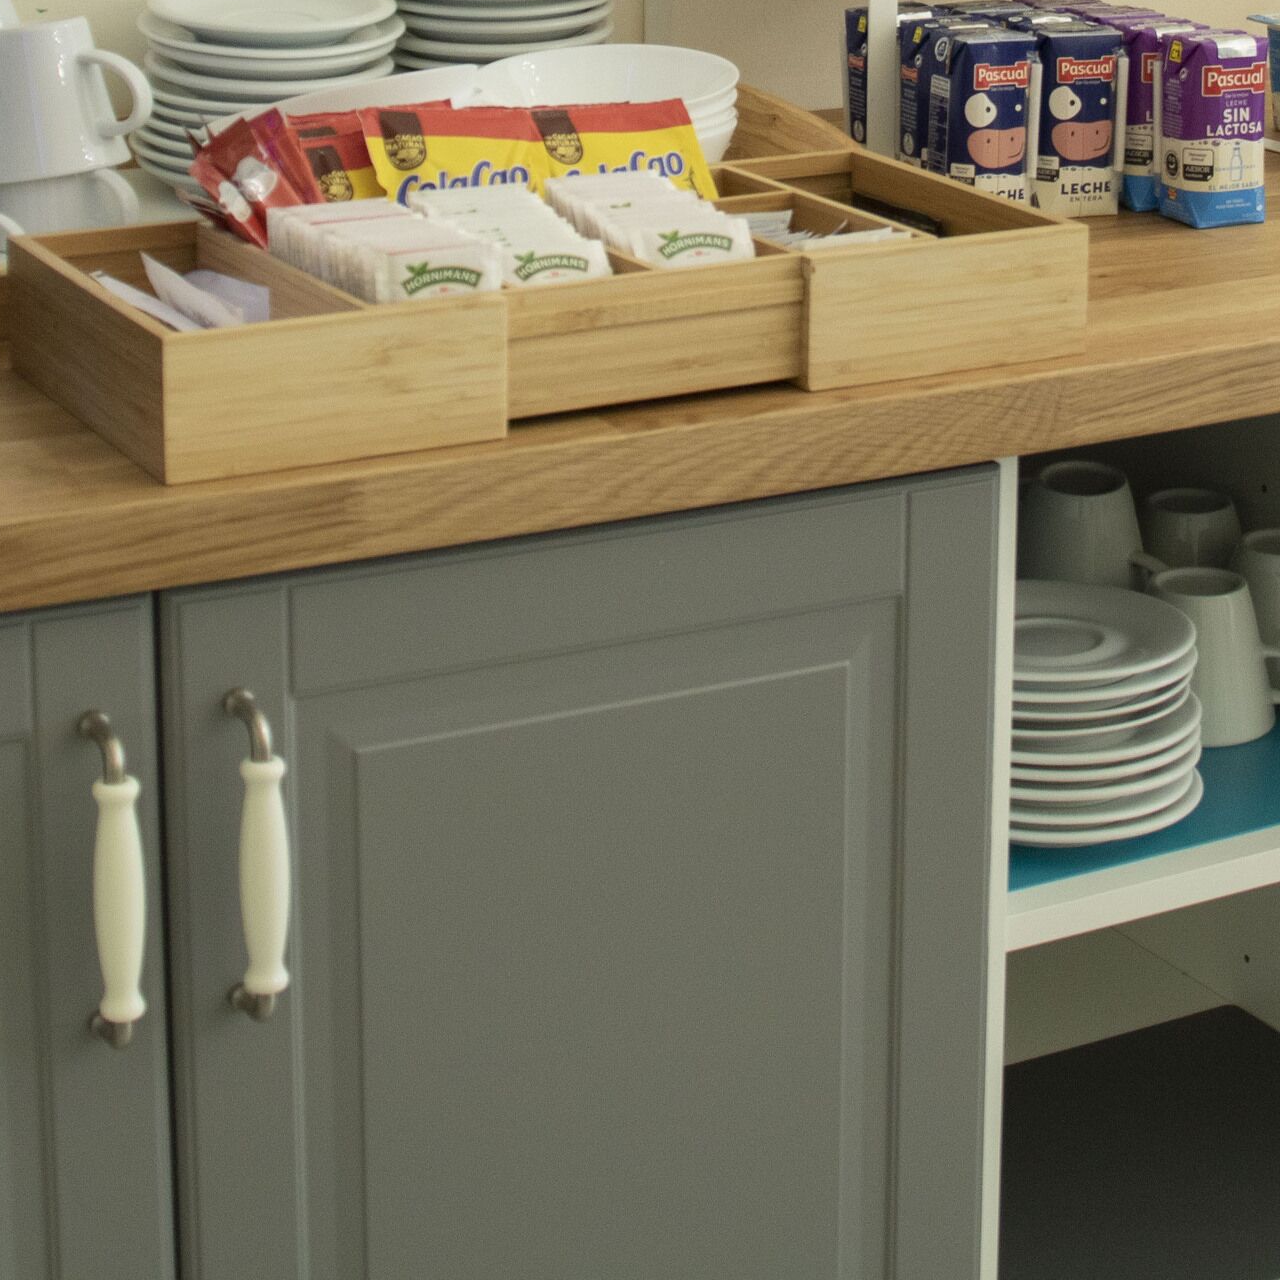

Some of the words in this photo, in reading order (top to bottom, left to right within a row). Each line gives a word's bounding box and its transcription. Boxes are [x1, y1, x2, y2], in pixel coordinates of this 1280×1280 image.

[978, 66, 1027, 82] Pascual
[1061, 61, 1113, 75] Pascual
[1208, 68, 1263, 87] Pascual
[1226, 99, 1248, 107] LECHE
[1223, 107, 1250, 123] SIN
[1206, 122, 1262, 137] LACTOSA
[1061, 181, 1111, 195] LECHE
[663, 236, 730, 258] HORNIMANS
[519, 257, 586, 279] HORNIMANS
[405, 269, 479, 292] HORNIMANS
